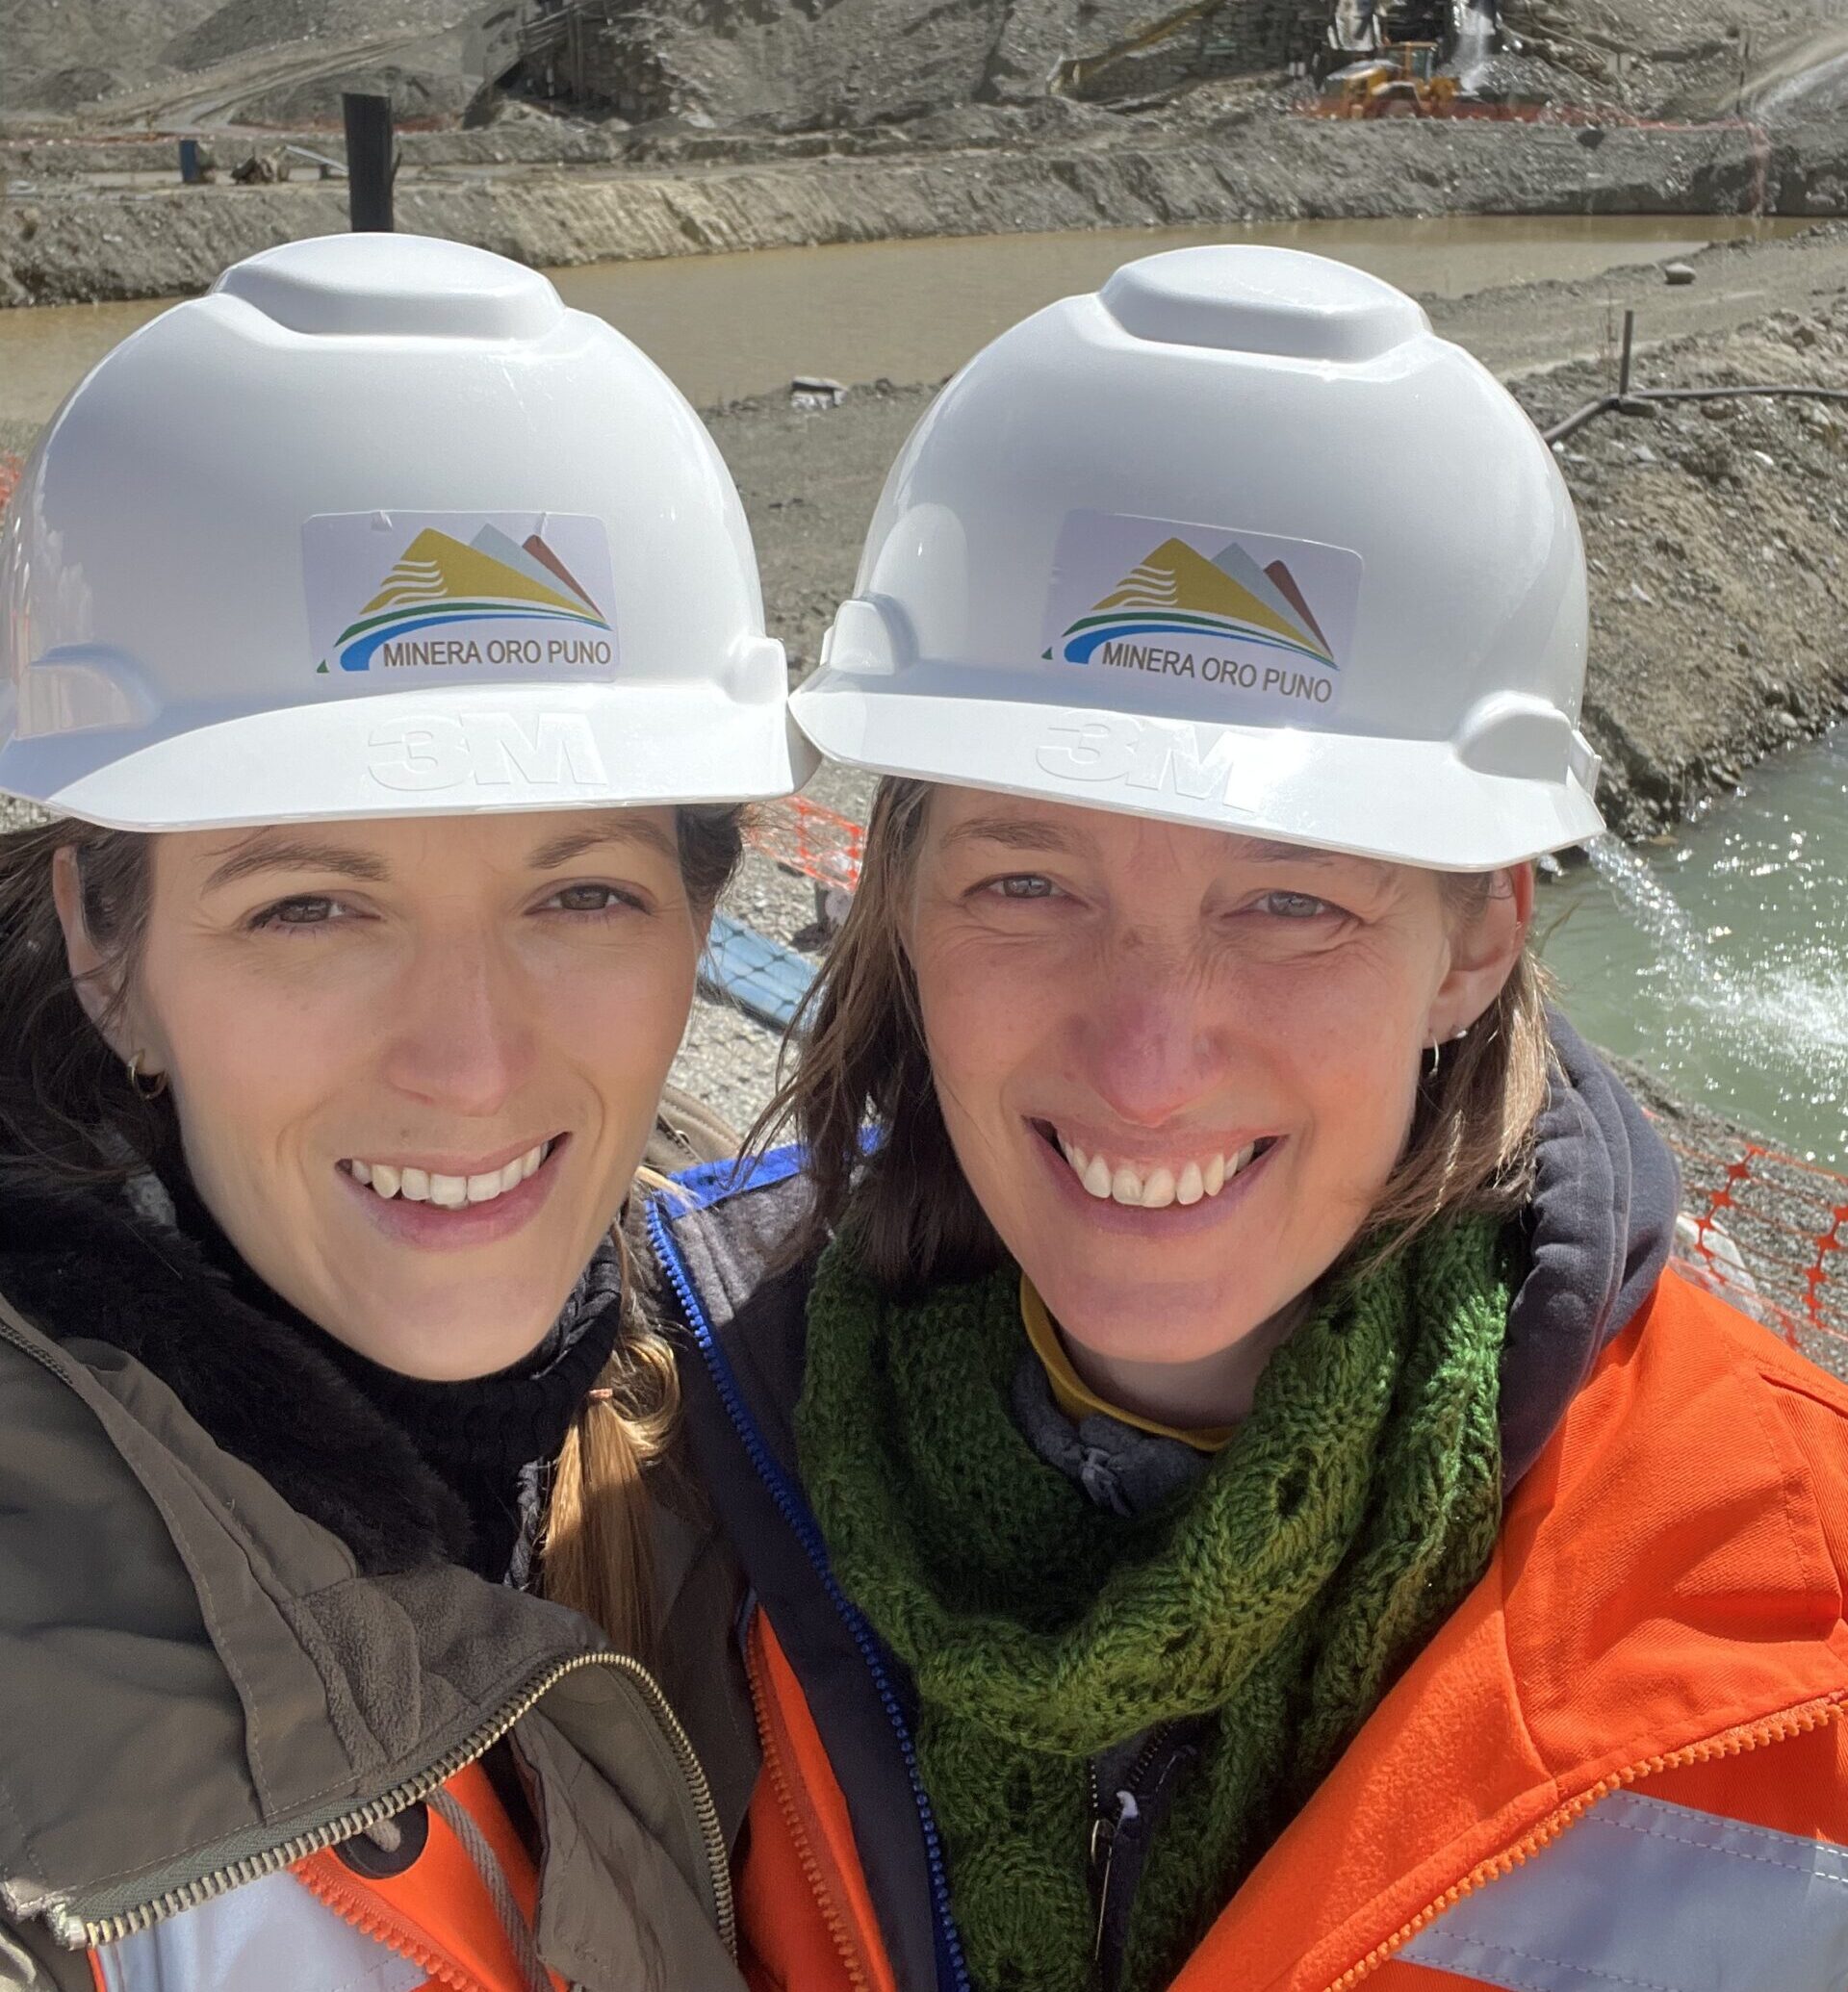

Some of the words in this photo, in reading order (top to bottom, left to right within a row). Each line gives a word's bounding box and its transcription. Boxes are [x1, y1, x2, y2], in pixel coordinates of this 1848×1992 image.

[384, 641, 482, 667] MINERA
[487, 640, 541, 664] ORO
[549, 640, 611, 664] PUNO
[1102, 642, 1194, 677] MINERA
[1202, 657, 1257, 688] ORO
[1263, 668, 1332, 702] PUNO
[369, 712, 607, 791] 3M
[1036, 710, 1265, 812] 3M
